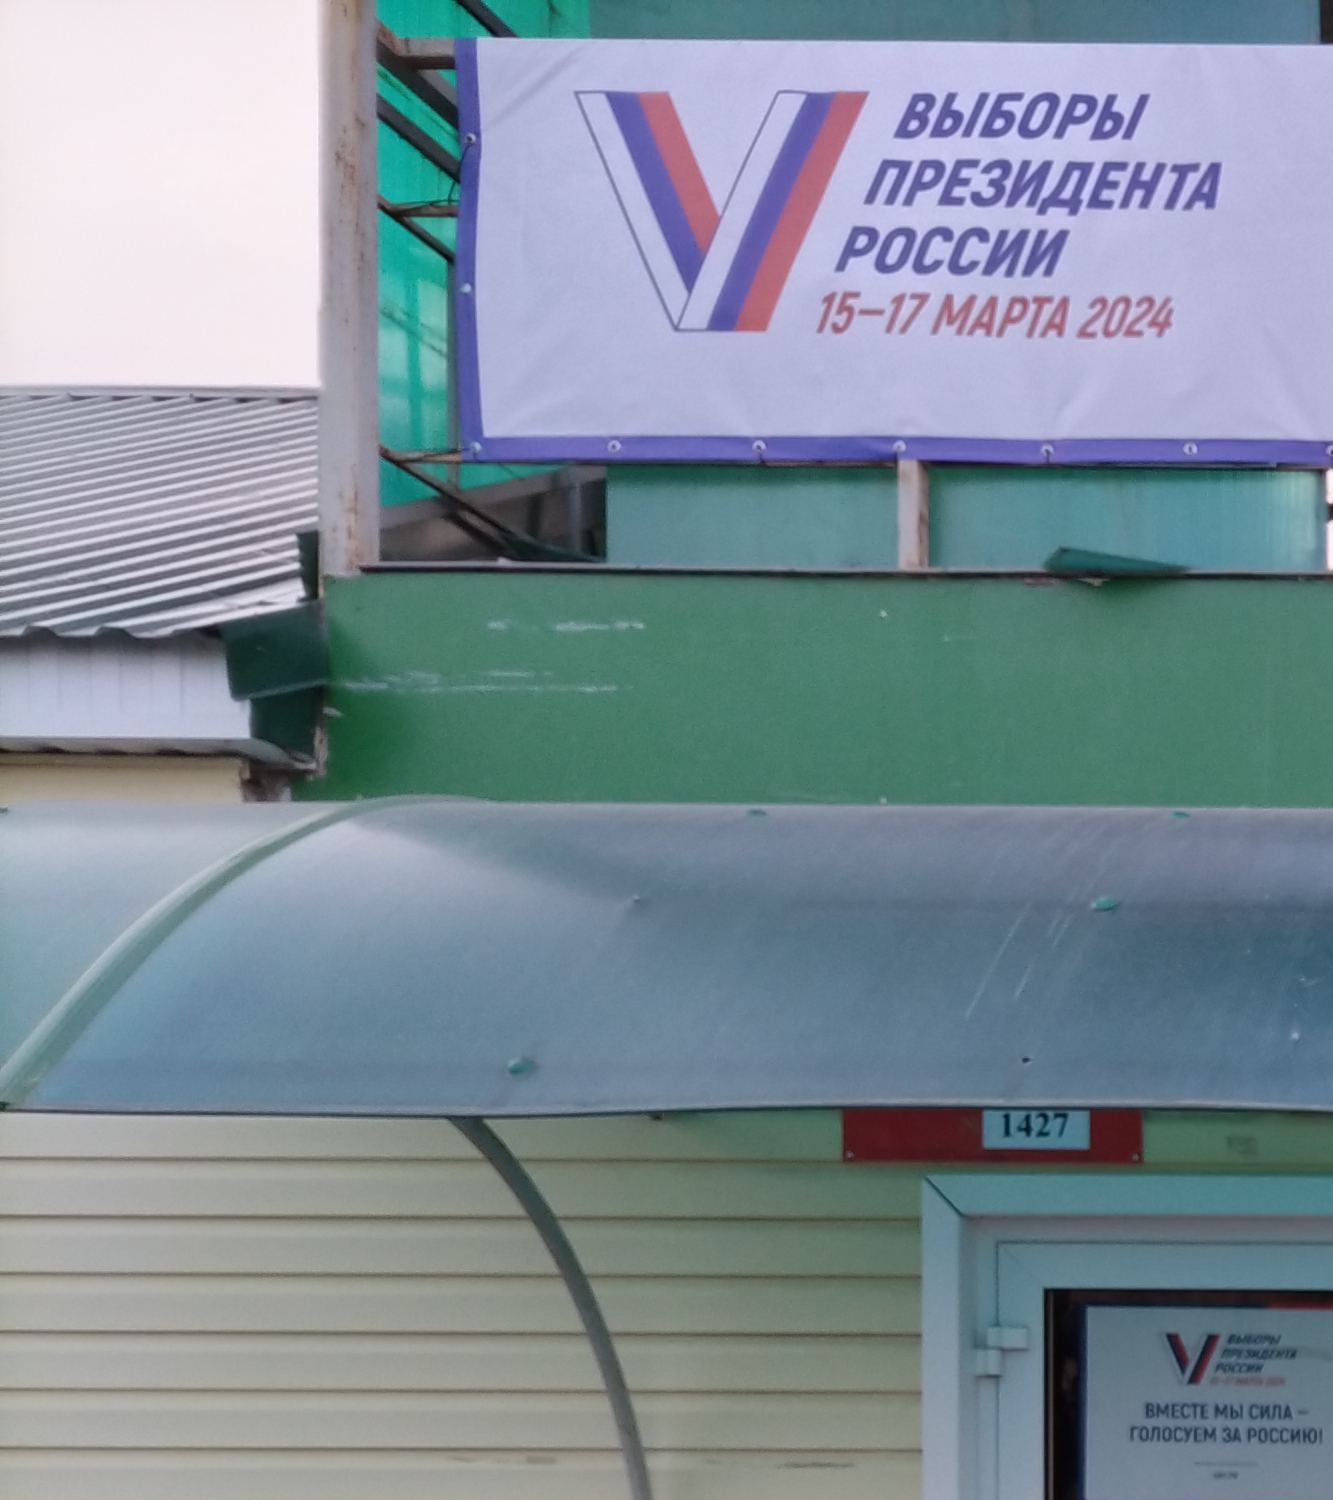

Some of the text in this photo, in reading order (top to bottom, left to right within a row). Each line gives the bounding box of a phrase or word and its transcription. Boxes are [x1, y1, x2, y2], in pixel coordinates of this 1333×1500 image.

[893, 92, 1150, 141] ВЫБОРЫ
[863, 158, 1223, 215] ПРЕЗИДЕНТА
[835, 226, 1070, 278] РОССИИ
[930, 295, 1071, 338] МАРТА
[1076, 297, 1176, 340] 2024
[1001, 1112, 1069, 1138] 1427
[1144, 1402, 1209, 1419] ВМЕСТЕ
[1215, 1403, 1244, 1420] МЫ
[1250, 1404, 1293, 1421] СИЛА
[1130, 1426, 1324, 1445] ГОЛОСУЕМ ЗА РОССИЮ!
